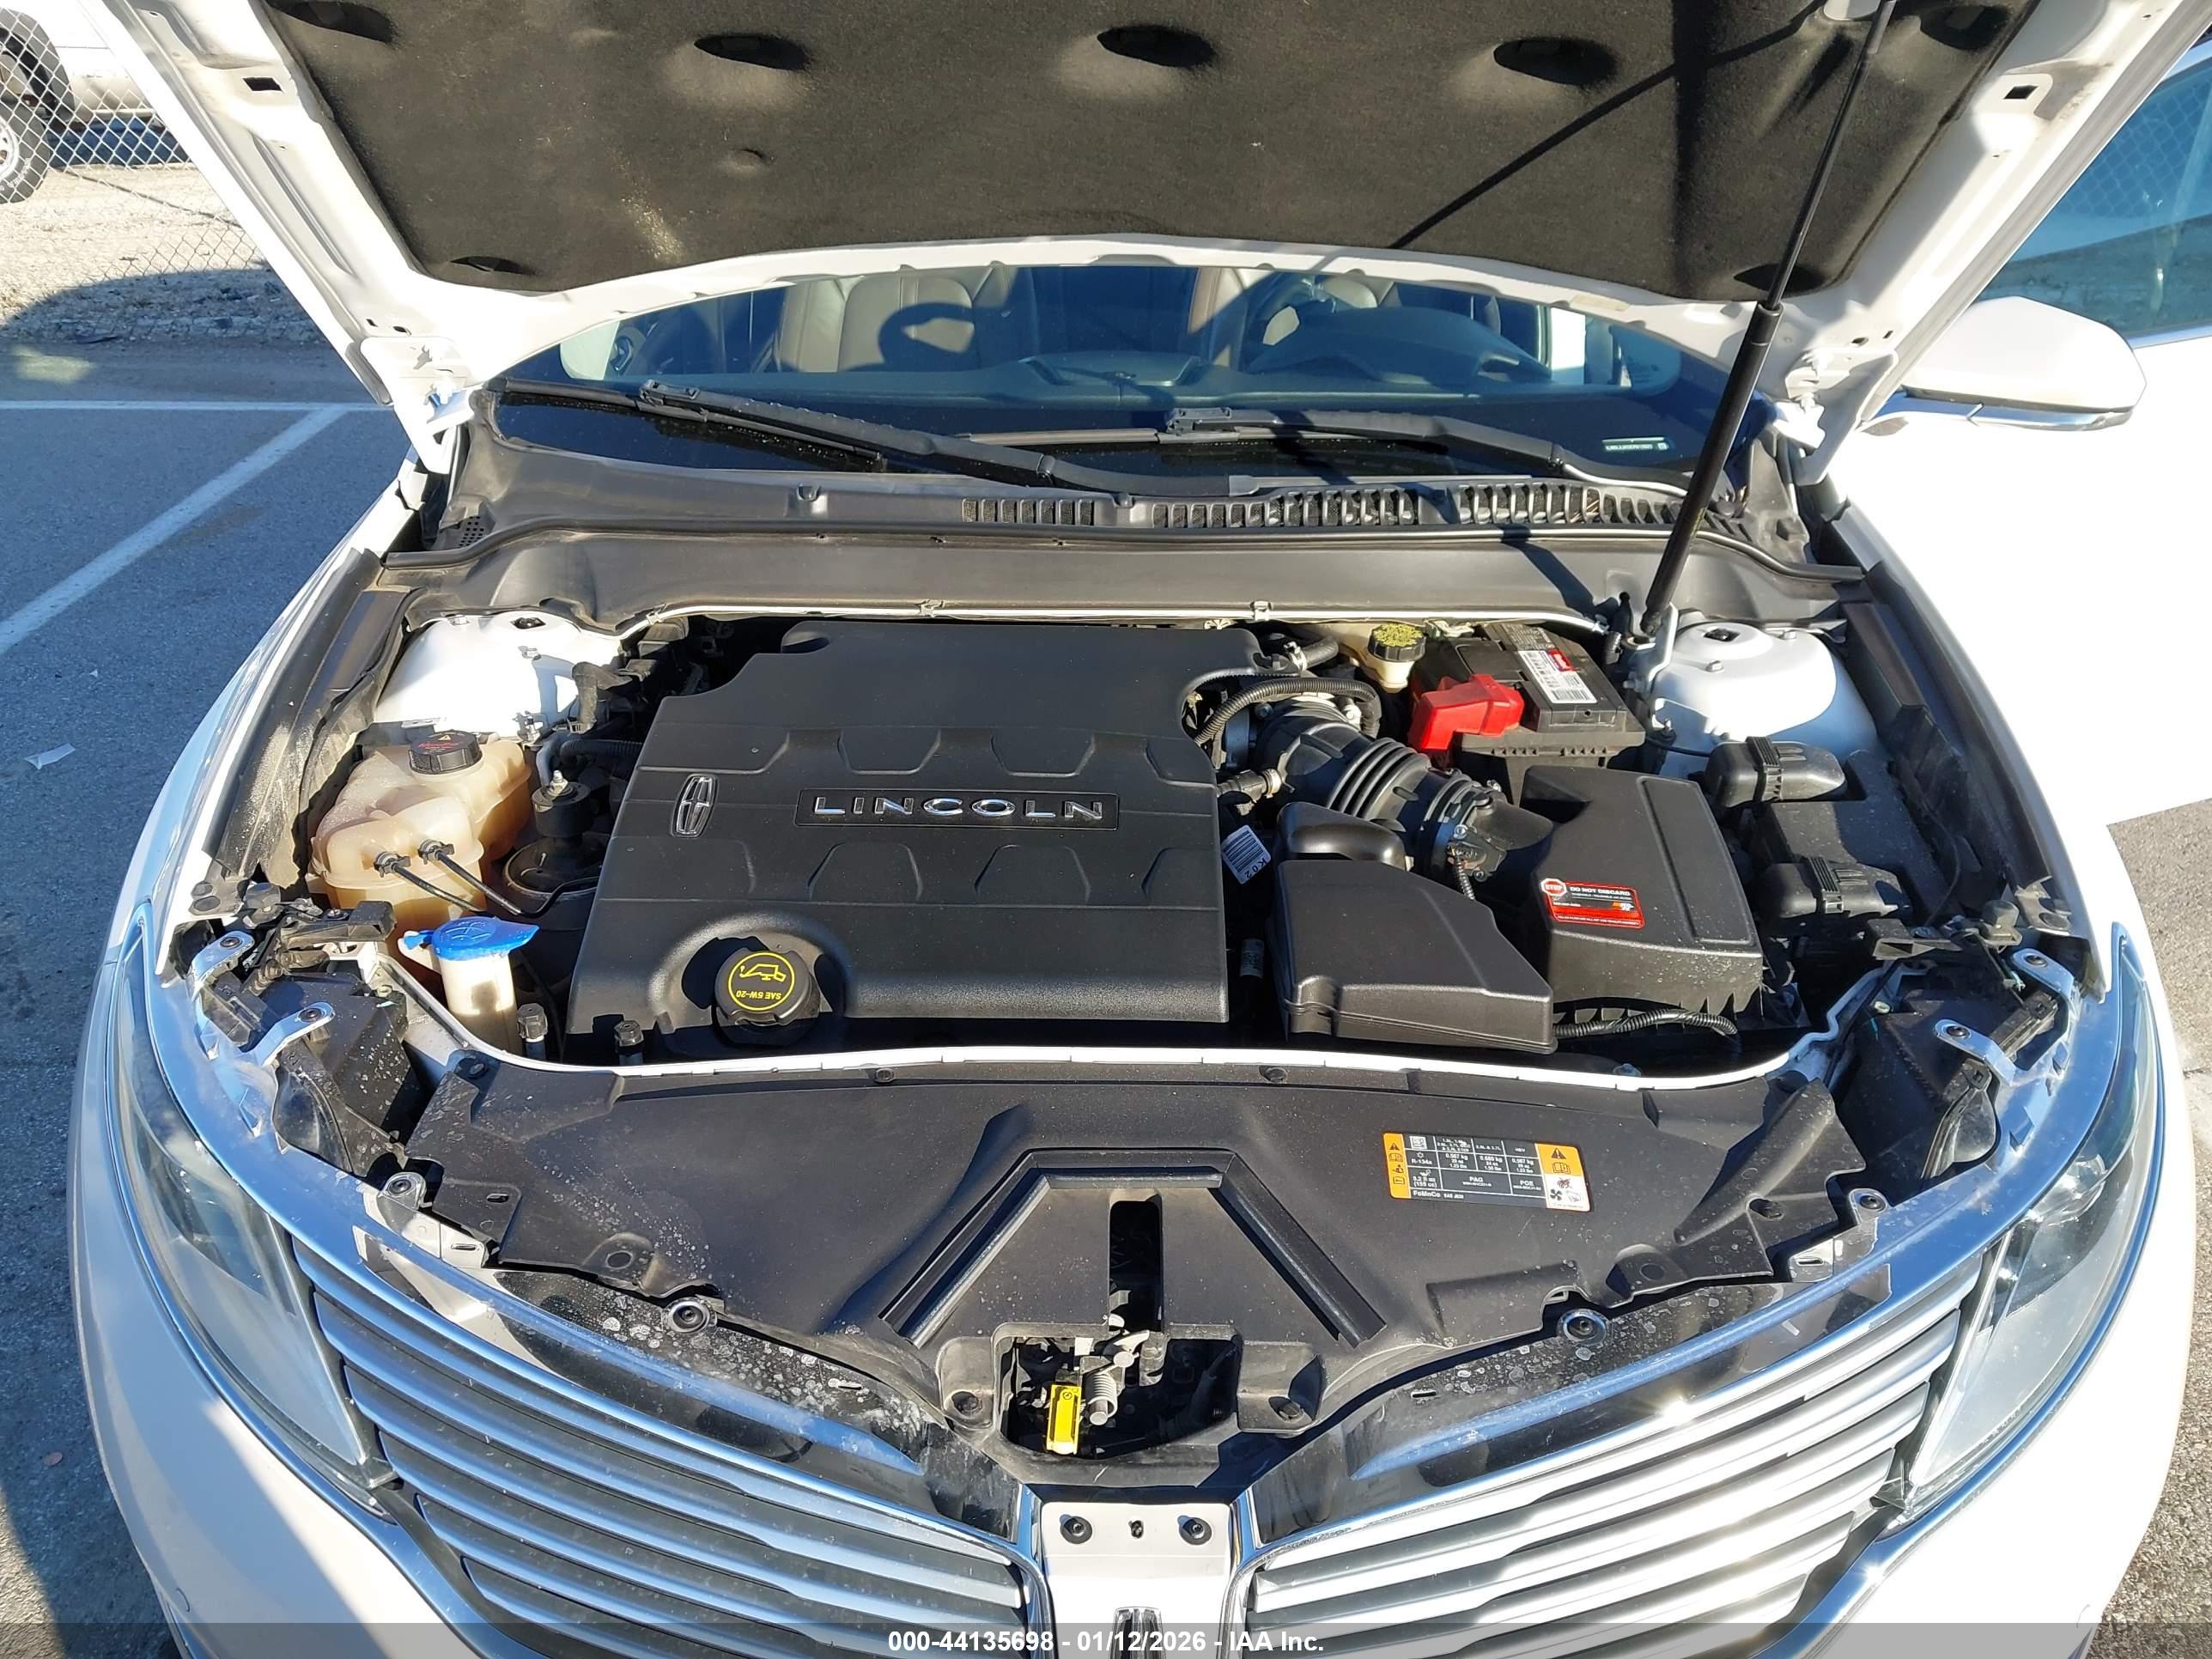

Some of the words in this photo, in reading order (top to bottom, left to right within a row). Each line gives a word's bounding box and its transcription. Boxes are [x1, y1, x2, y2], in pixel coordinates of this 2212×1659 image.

[814, 796, 1103, 818] LINCOLN
[1245, 857, 1267, 878] K02
[1597, 887, 1631, 896] DISCARD
[736, 990, 763, 999] 5W-20
[765, 992, 781, 1000] SAE
